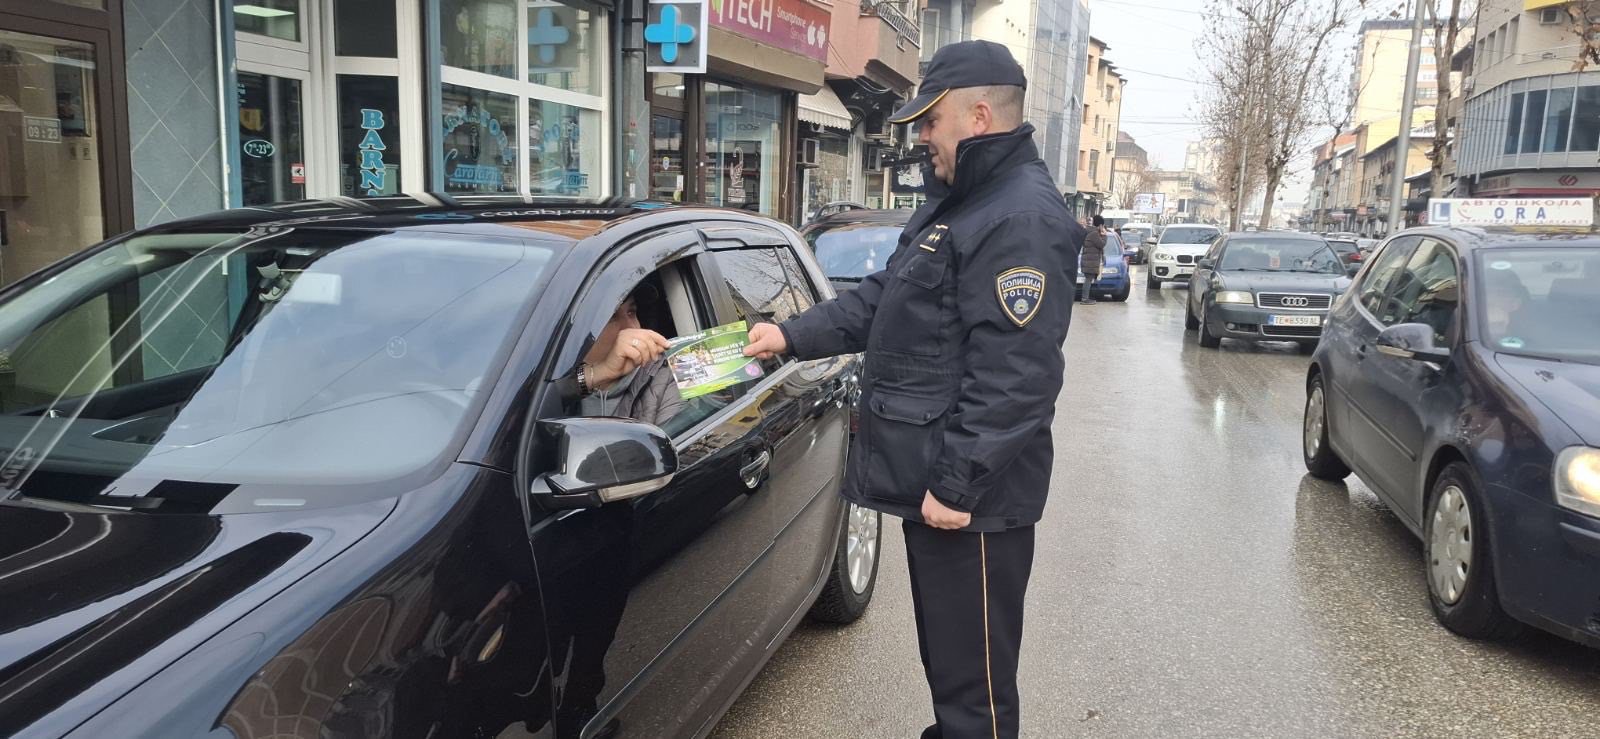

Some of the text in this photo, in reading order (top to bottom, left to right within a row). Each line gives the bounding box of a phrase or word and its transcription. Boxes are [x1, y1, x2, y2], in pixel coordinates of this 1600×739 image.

[1515, 199, 1582, 207] ШКОЛА
[1494, 207, 1546, 220] ORA
[1001, 277, 1041, 290] ПОЛИЦИЈА
[1003, 289, 1040, 300] POLICE
